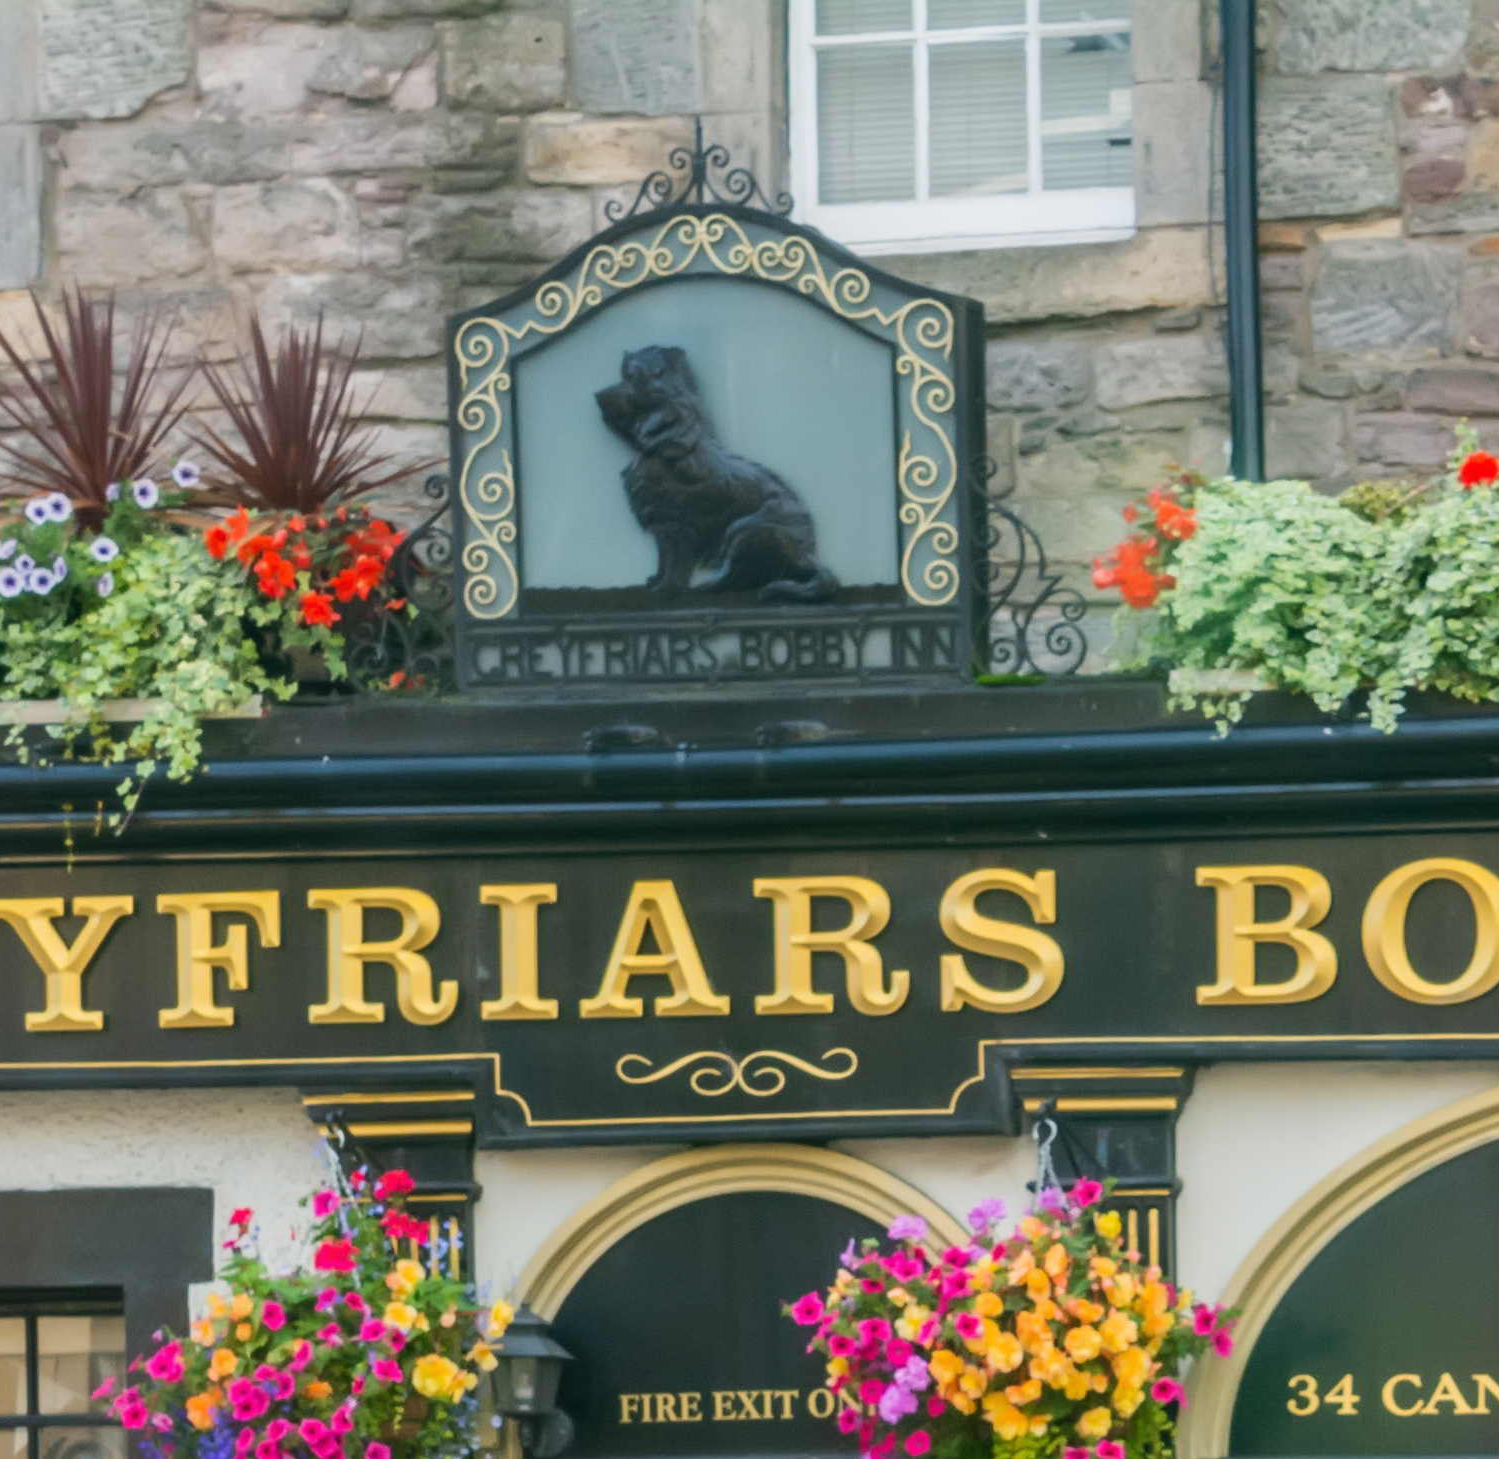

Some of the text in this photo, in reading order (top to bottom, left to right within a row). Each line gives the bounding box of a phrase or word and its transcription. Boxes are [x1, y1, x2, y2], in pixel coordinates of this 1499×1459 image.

[472, 624, 957, 680] GREYFRIARS BOBBY INN
[619, 1387, 878, 1425] FIRE EXIT ON
[1286, 1373, 1360, 1416] 34
